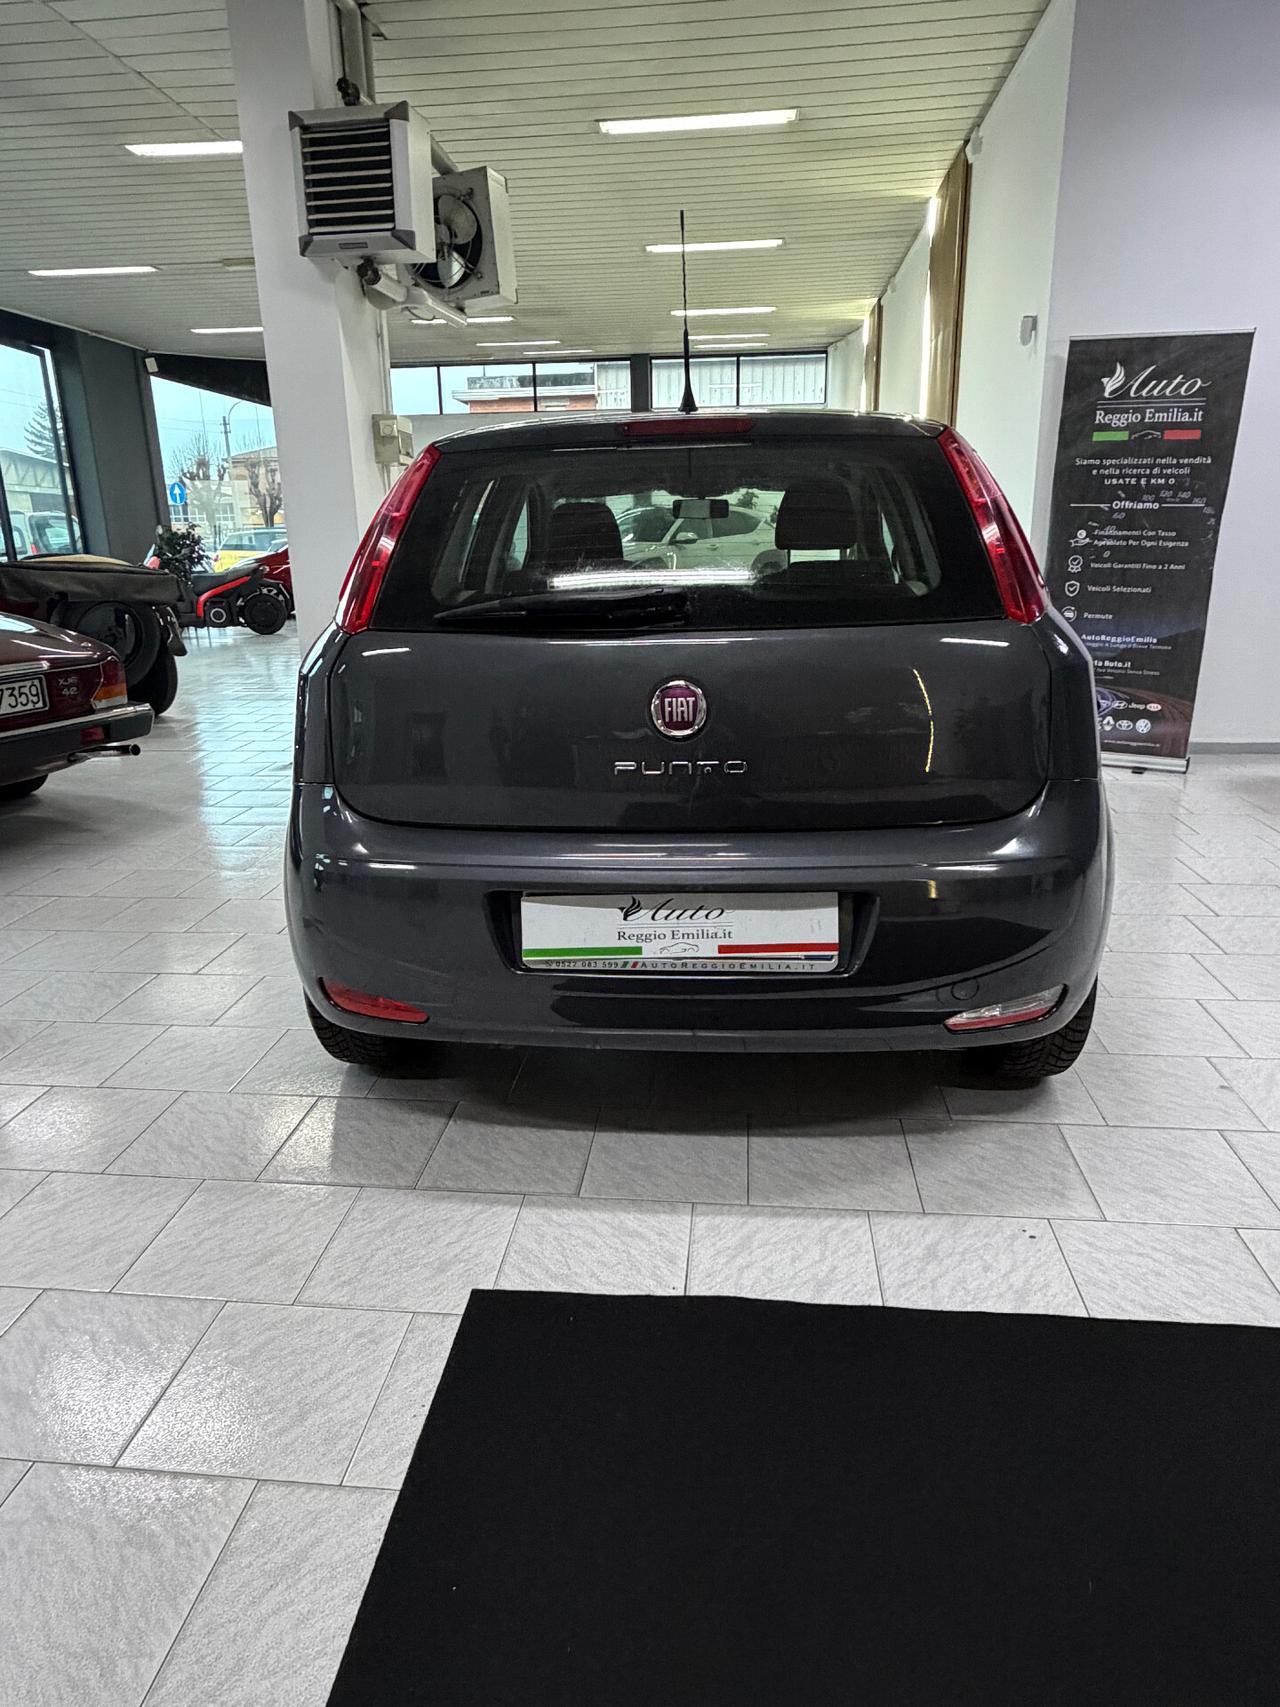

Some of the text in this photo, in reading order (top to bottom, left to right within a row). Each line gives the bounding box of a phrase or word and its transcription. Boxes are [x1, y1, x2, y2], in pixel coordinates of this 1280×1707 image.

[1104, 363, 1212, 398] Auto
[1095, 408, 1203, 427] Reggio Emilia.it
[1075, 458, 1101, 466] Siamo
[1102, 457, 1154, 467] specializzati
[1155, 456, 1177, 464] nella
[1121, 467, 1150, 475] ricerca
[1162, 467, 1191, 475] veicoli
[1112, 501, 1160, 510] Offriamo
[1112, 585, 1152, 593] Selezionati
[1083, 612, 1113, 620] Permute
[664, 697, 695, 722] FIAT
[614, 760, 748, 775] PUNTO
[622, 897, 733, 922] Auto
[617, 928, 733, 943] Reggio Emilia.it
[640, 961, 816, 970] AUTOREGGIOEMILIA.IT
